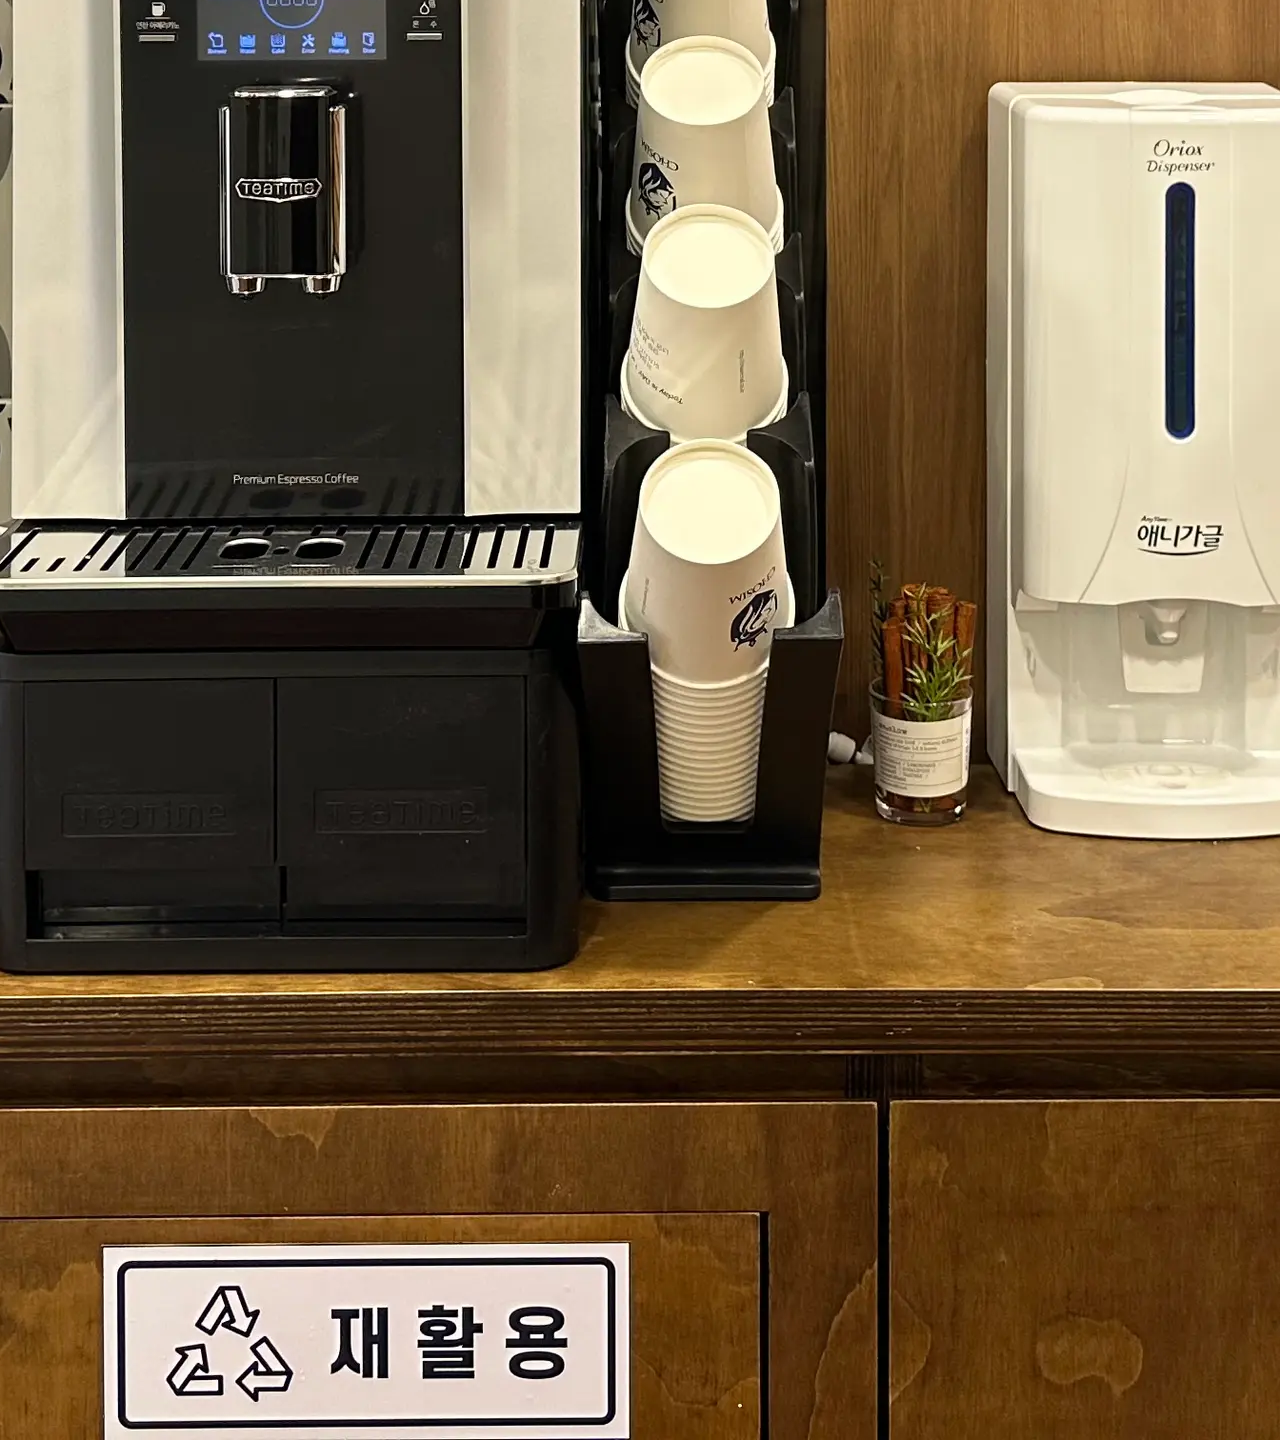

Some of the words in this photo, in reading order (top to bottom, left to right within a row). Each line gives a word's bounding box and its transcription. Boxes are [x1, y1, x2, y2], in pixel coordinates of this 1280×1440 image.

[1153, 139, 1205, 157] Oriox
[1146, 160, 1216, 176] Dispenser
[233, 474, 276, 485] Premium
[277, 474, 323, 485] Espresso
[325, 474, 359, 485] Coffee
[1137, 525, 1224, 548] 애니가글
[728, 565, 776, 605] CHOSIM
